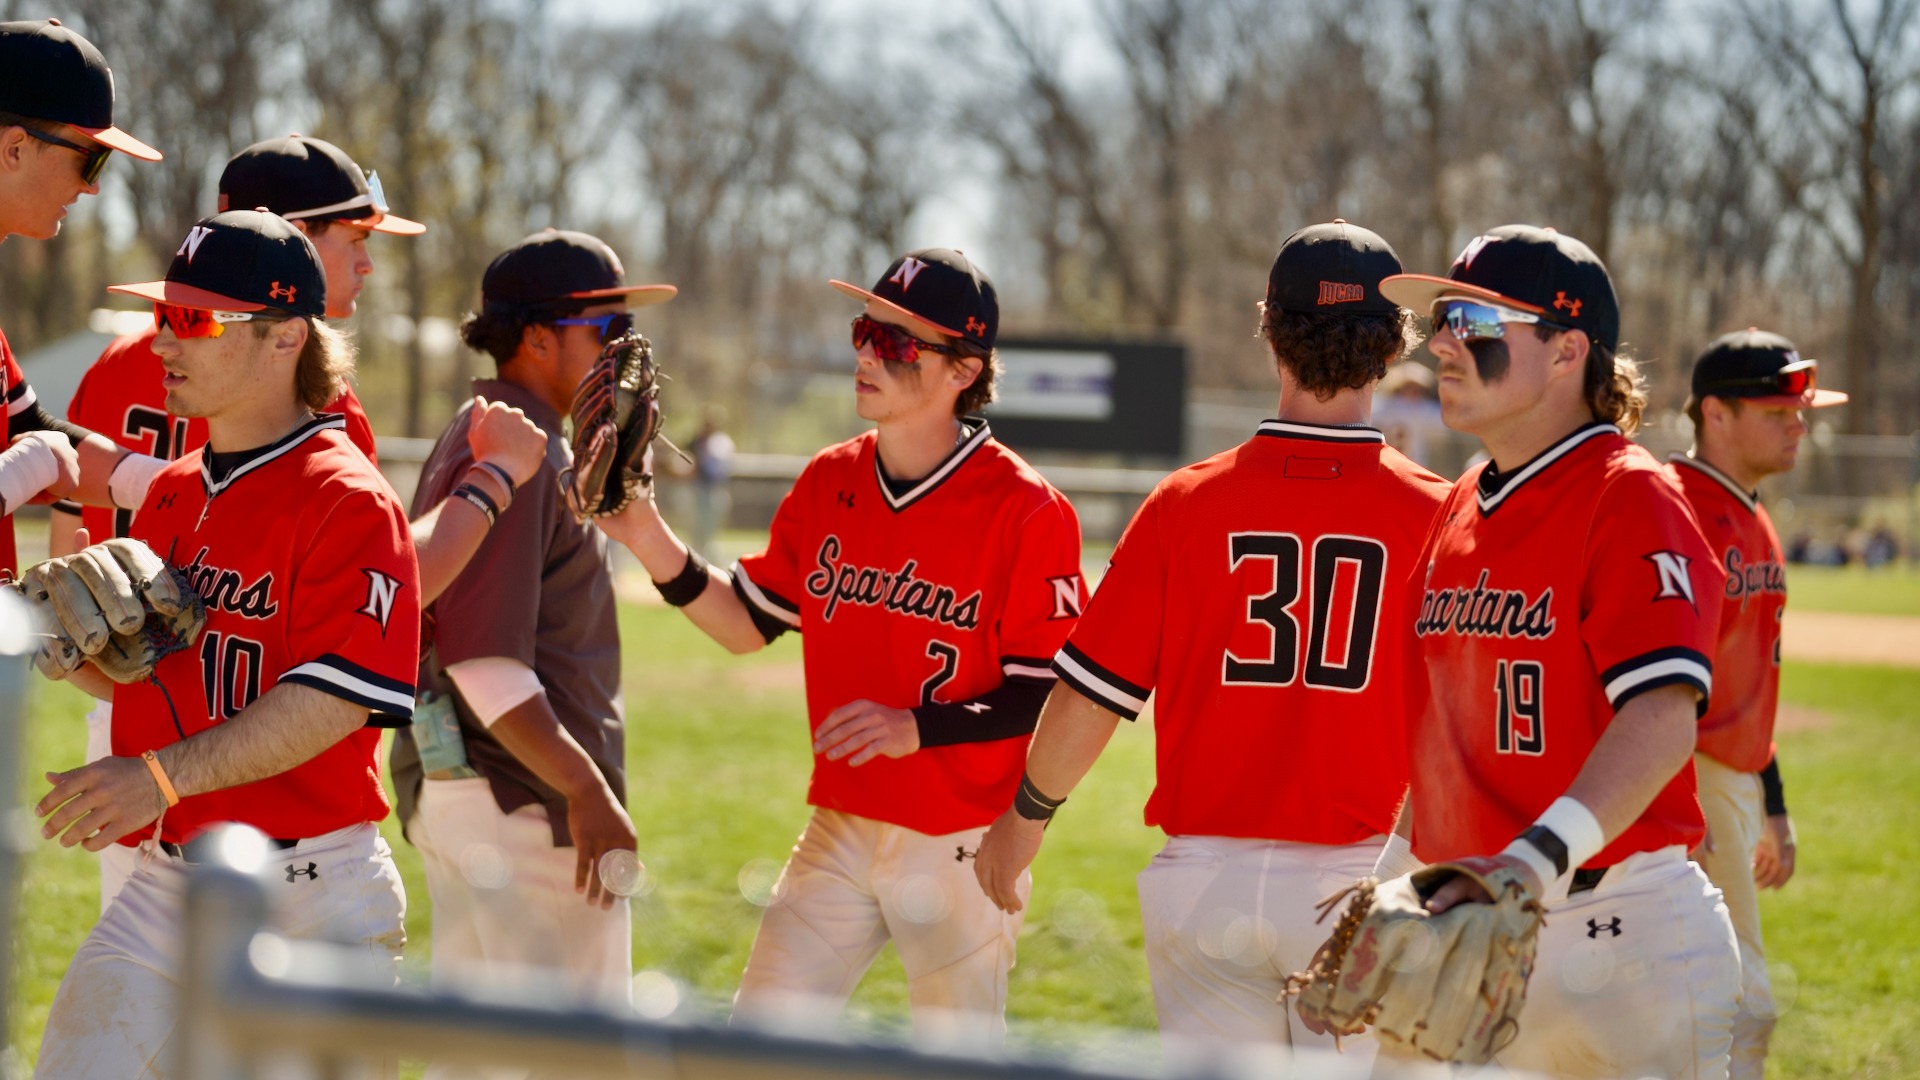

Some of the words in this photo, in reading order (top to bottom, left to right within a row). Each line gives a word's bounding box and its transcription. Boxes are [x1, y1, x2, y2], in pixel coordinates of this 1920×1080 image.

[176, 225, 214, 264] N
[888, 256, 929, 293] N
[179, 545, 279, 621] tans
[356, 568, 404, 639] N
[805, 533, 983, 631] Spartans
[1045, 574, 1083, 621] N
[1221, 530, 1389, 694] 30
[1643, 549, 1699, 616] N
[200, 630, 264, 721] 10
[919, 638, 959, 707] 2
[1494, 658, 1546, 758] 19
